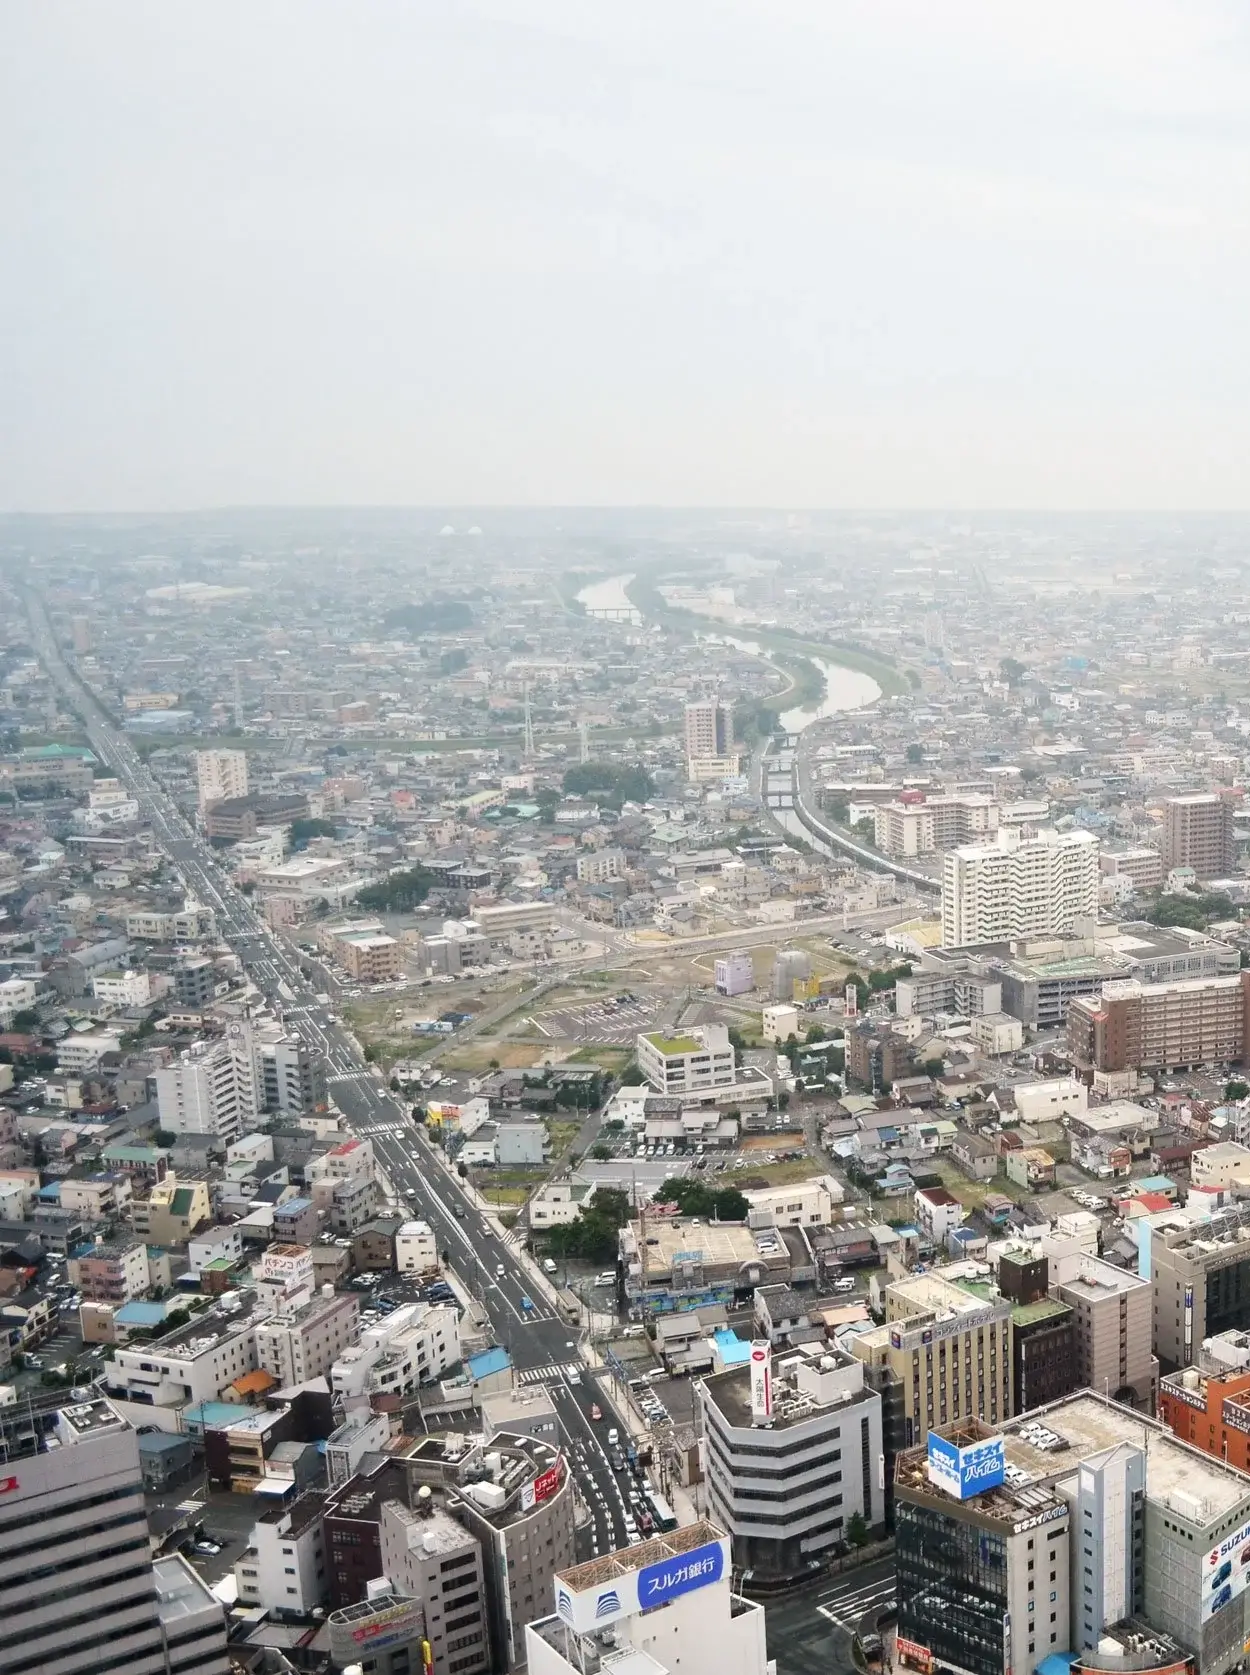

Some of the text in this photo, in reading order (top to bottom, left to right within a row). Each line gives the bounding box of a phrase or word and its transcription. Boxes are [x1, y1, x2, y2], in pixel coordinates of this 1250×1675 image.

[963, 1440, 1003, 1466] セキスイ
[964, 1457, 1001, 1483] ハイム
[1012, 1503, 1069, 1534] セキスイハイム
[647, 1556, 715, 1595] スルガ銀行
